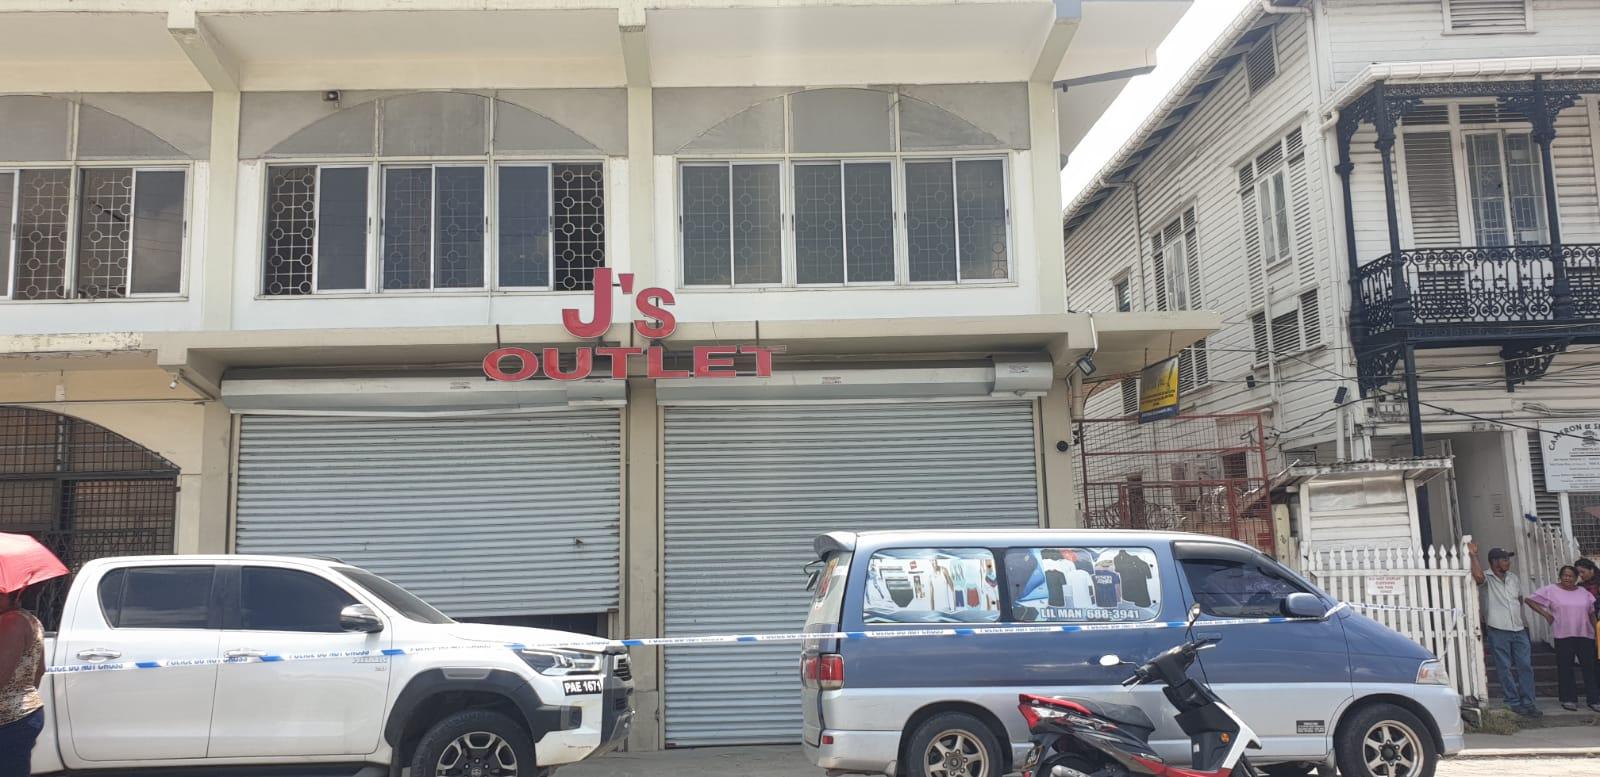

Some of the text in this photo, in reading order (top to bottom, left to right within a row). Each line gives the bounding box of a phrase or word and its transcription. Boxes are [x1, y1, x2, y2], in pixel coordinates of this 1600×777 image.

[561, 267, 676, 339] J's
[482, 345, 787, 382] OUTLET
[1548, 423, 1582, 451] CAMERON
[1040, 607, 1140, 620] LIL MAN 688-3941
[564, 680, 602, 694] PAE 1671
